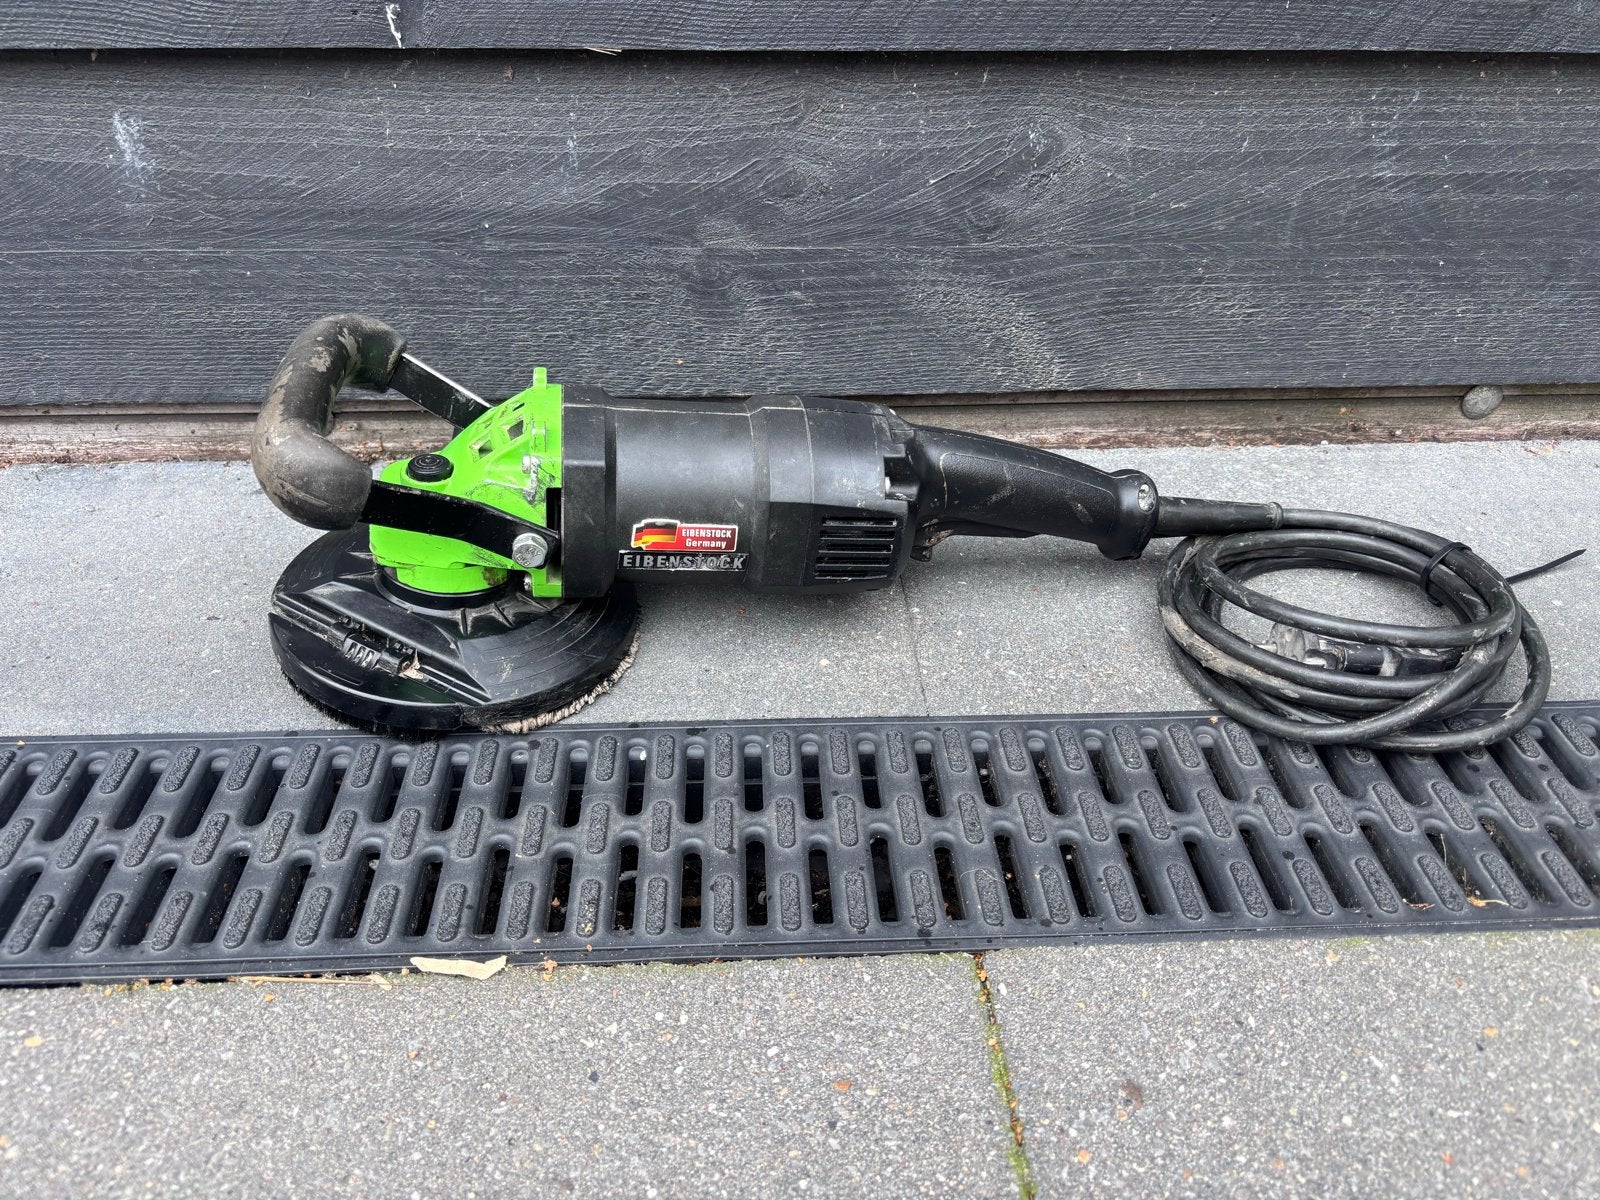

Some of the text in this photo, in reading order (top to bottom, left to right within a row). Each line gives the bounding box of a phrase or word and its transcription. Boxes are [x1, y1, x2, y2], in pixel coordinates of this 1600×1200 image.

[681, 529, 732, 538] EIBENSTOCK
[685, 538, 727, 549] Germany
[622, 554, 745, 569] EIBENSTOCK
